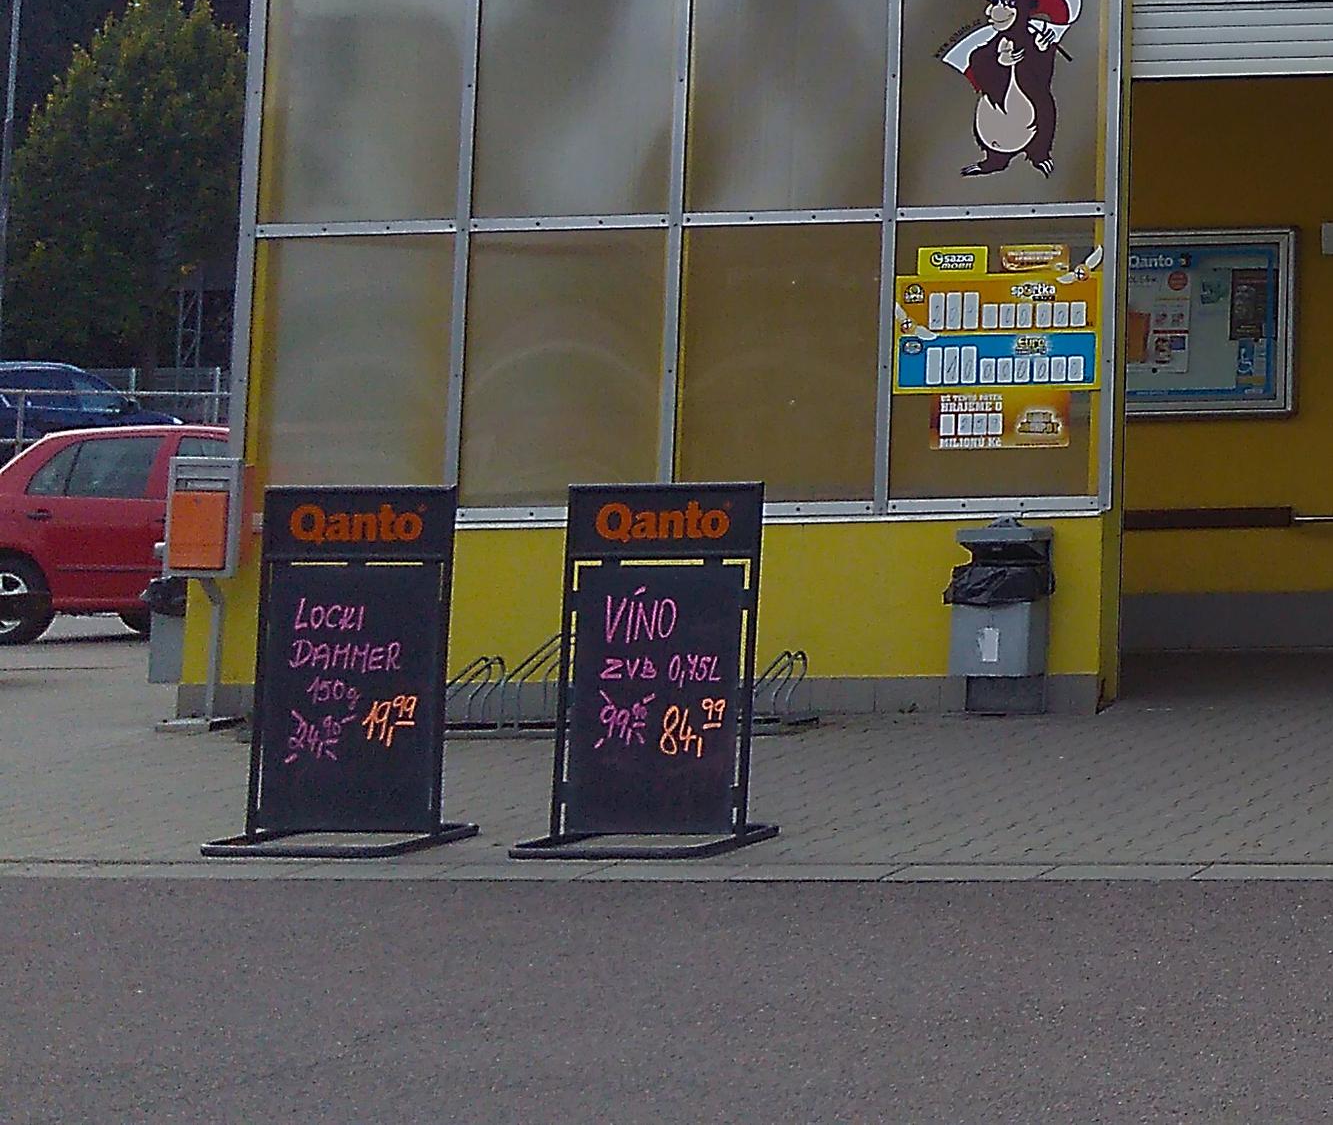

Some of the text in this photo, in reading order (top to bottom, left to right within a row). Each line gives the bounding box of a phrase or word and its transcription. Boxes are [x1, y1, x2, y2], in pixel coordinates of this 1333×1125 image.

[290, 502, 424, 544] Qanto
[595, 500, 731, 544] Qanto
[603, 586, 678, 644] VÍNO
